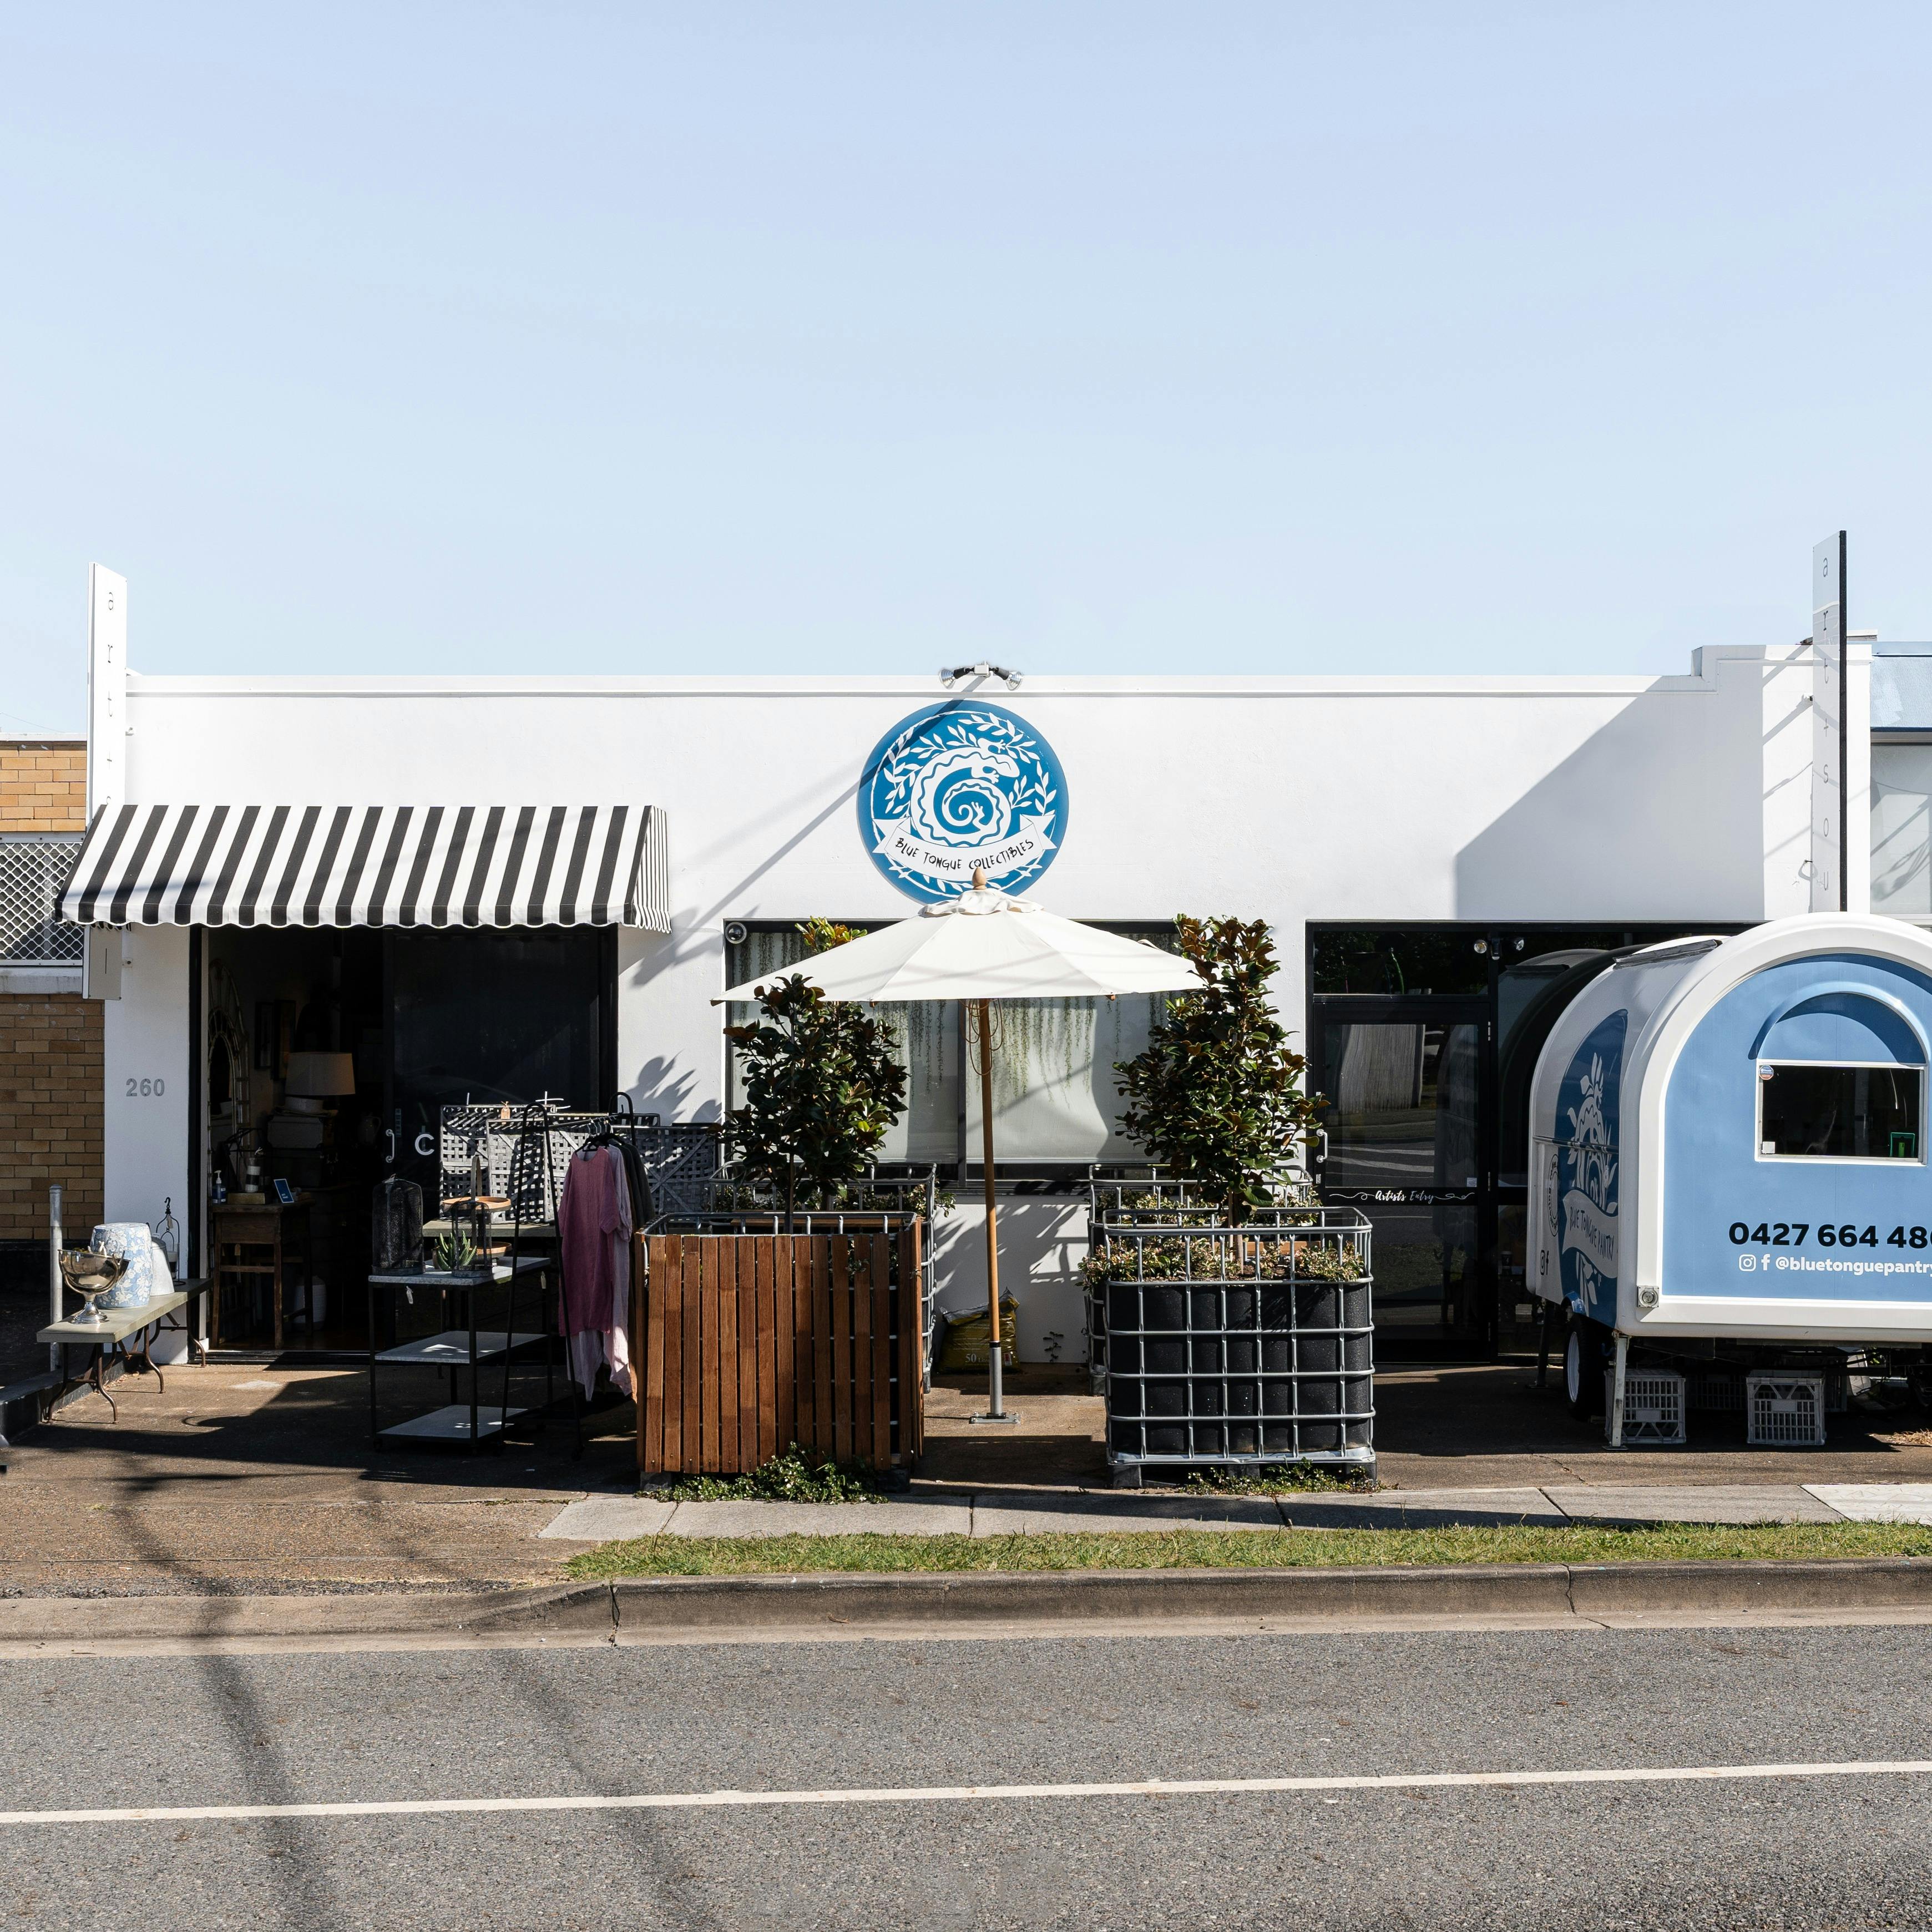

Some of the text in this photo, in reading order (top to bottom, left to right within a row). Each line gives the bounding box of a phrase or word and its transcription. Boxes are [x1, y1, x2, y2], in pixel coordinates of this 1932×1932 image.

[895, 837, 1034, 871] BLUE TONGUE COLLECTIBLES
[126, 1078, 165, 1096] 260
[1375, 1190, 1434, 1204] Artists Entry
[1570, 1206, 1615, 1261] BLUE TONGUE PANTRY
[1729, 1222, 1932, 1249] 0427 664 48
[1776, 1256, 1932, 1278] @bluetonguepantr
[965, 1353, 977, 1363] 50
